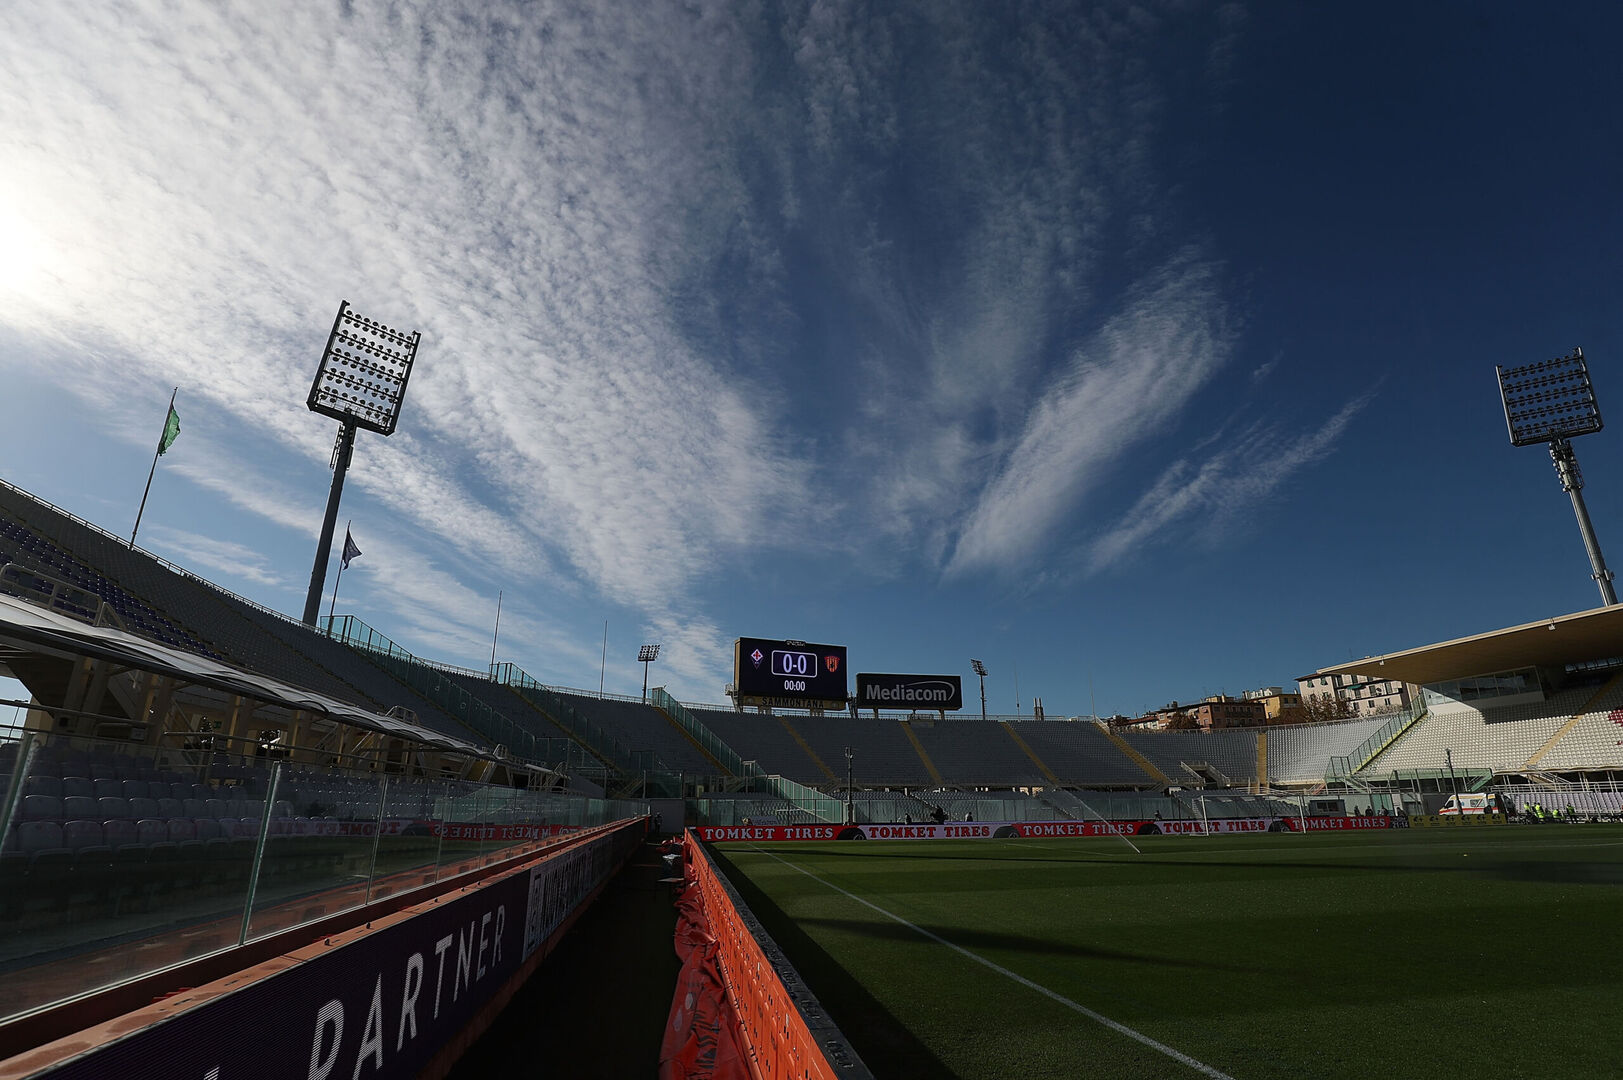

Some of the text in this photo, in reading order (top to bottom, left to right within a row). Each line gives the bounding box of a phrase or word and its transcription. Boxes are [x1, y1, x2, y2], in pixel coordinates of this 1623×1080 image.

[783, 654, 807, 675] 0-0
[784, 680, 806, 692] 00:00
[866, 684, 947, 702] Mediacom
[762, 697, 824, 708] SAMMONTANA
[1023, 823, 1134, 836] TOMKET TIRES
[1227, 821, 1265, 831] TIRES
[1293, 819, 1344, 829] TOMKET
[1350, 818, 1386, 828] TIRES
[705, 827, 834, 840] TOMKET TIRES
[869, 825, 990, 838] TOMKET TIRES
[308, 904, 505, 1080] PARTNER
